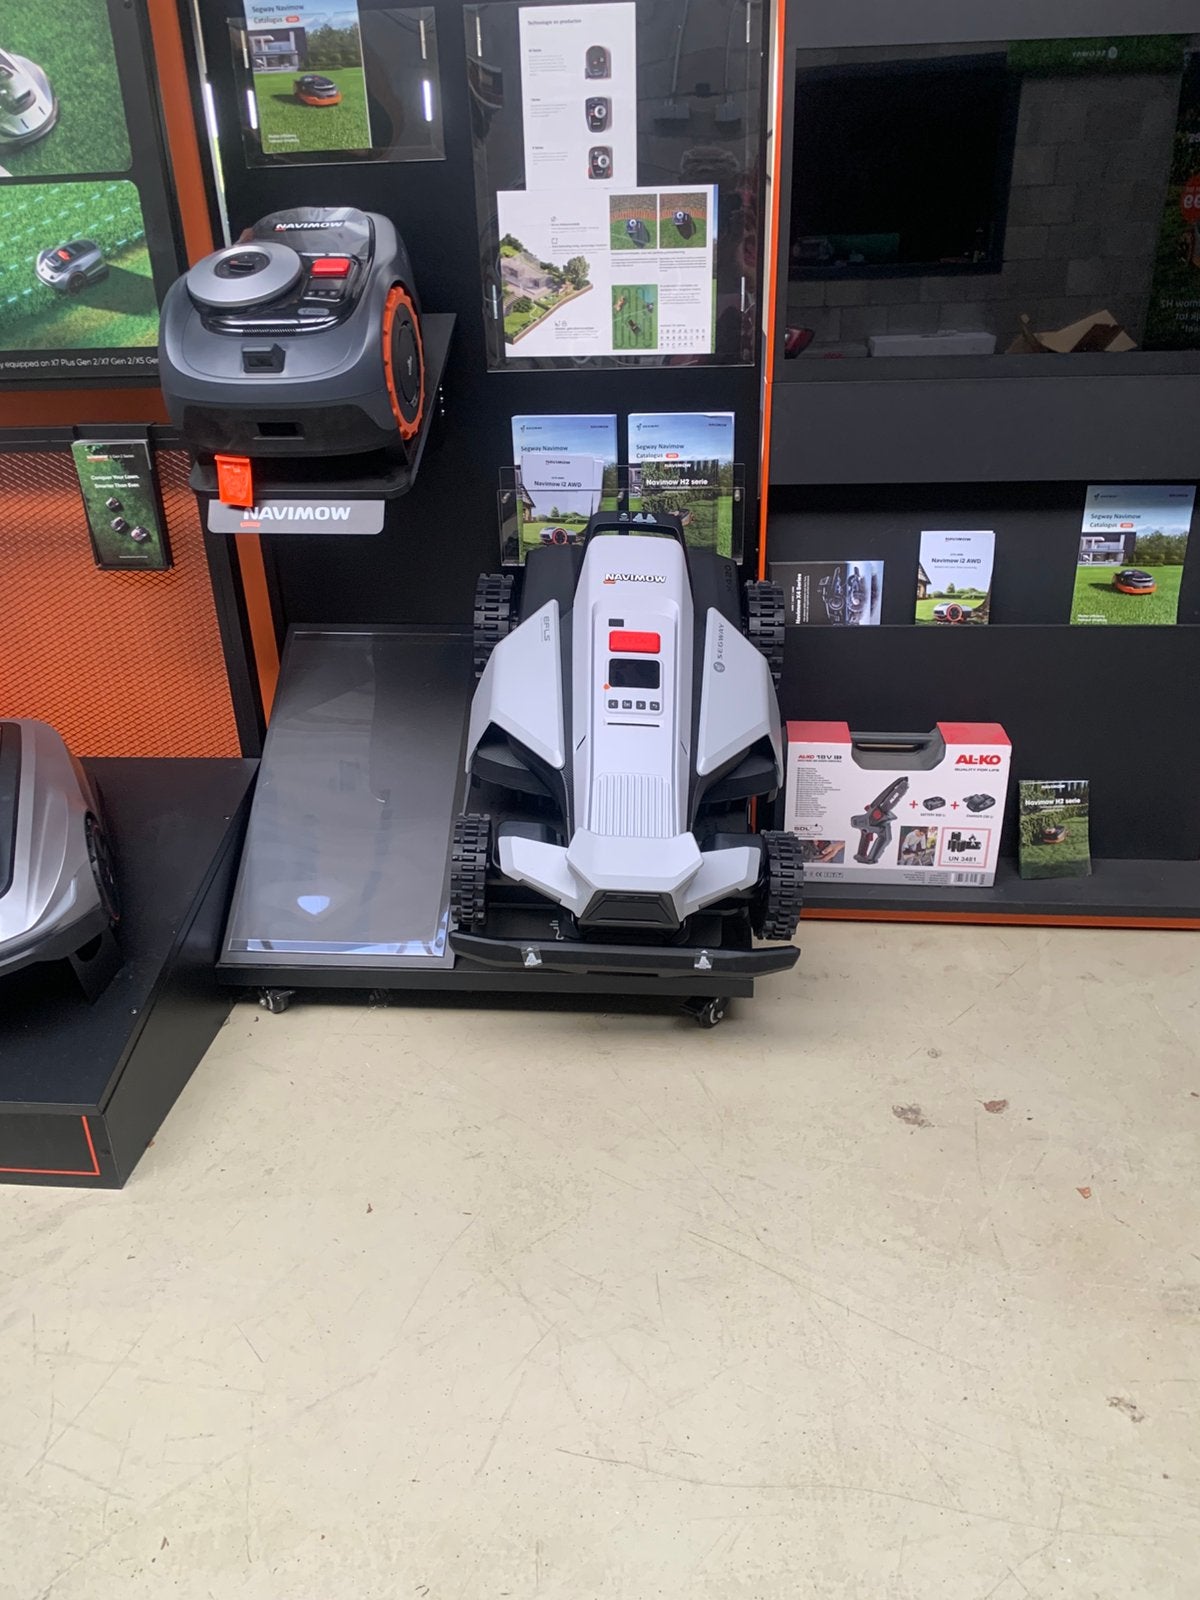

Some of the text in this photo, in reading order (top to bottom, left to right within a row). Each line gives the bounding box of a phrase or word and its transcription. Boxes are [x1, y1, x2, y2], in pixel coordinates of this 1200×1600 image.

[254, 16, 282, 24] Catalogus
[274, 220, 344, 230] NAVIMOW
[5, 360, 39, 368] equipped
[77, 358, 92, 366] Gen
[111, 357, 126, 365] Gen
[243, 506, 351, 520] NAVIMOW
[604, 573, 667, 584] NAVIMOW
[955, 755, 1002, 765] AL-KO
